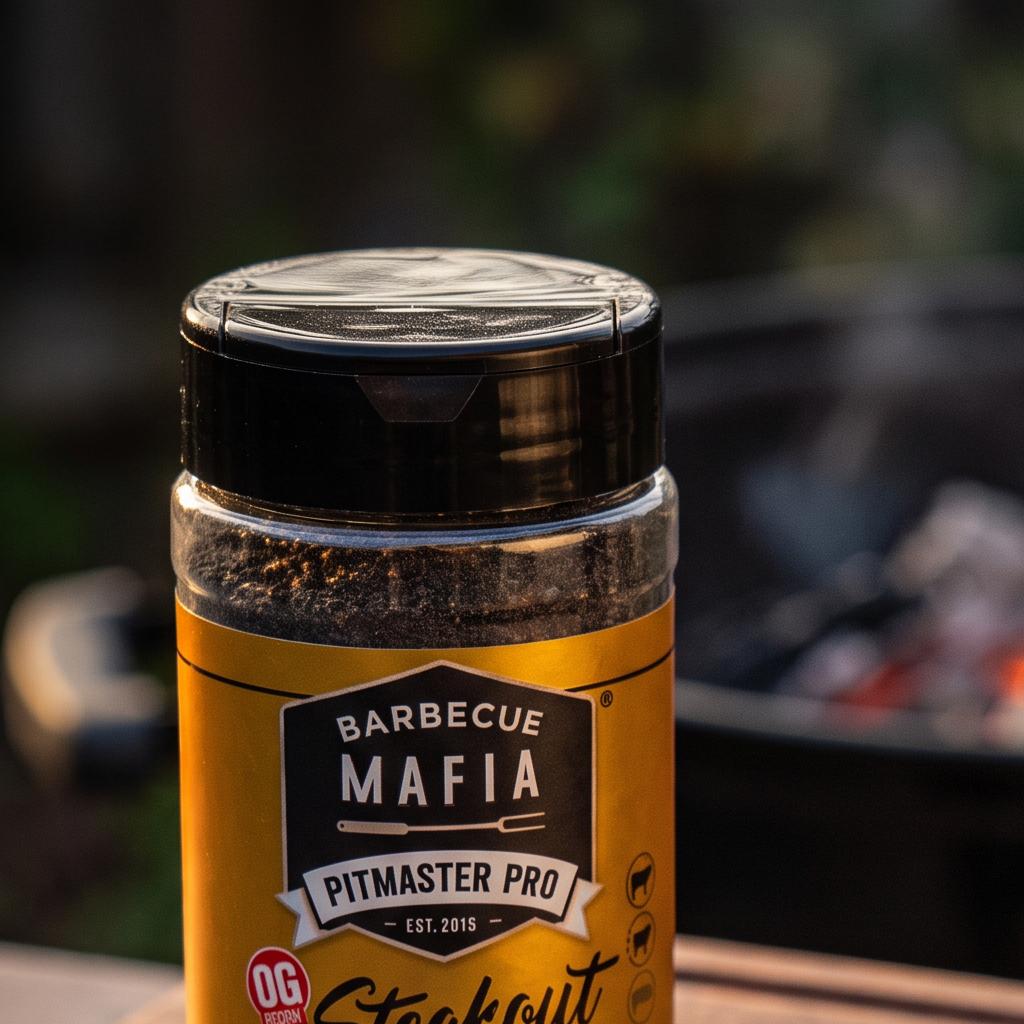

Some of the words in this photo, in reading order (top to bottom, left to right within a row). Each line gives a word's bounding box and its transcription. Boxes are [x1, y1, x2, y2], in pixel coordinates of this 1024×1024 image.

[336, 701, 544, 743] BARBECUE
[341, 749, 540, 807] MAFIA
[323, 862, 492, 907] PITMASTER
[502, 863, 559, 901] PRO
[406, 918, 437, 933] EST.
[252, 961, 303, 1008] OG
